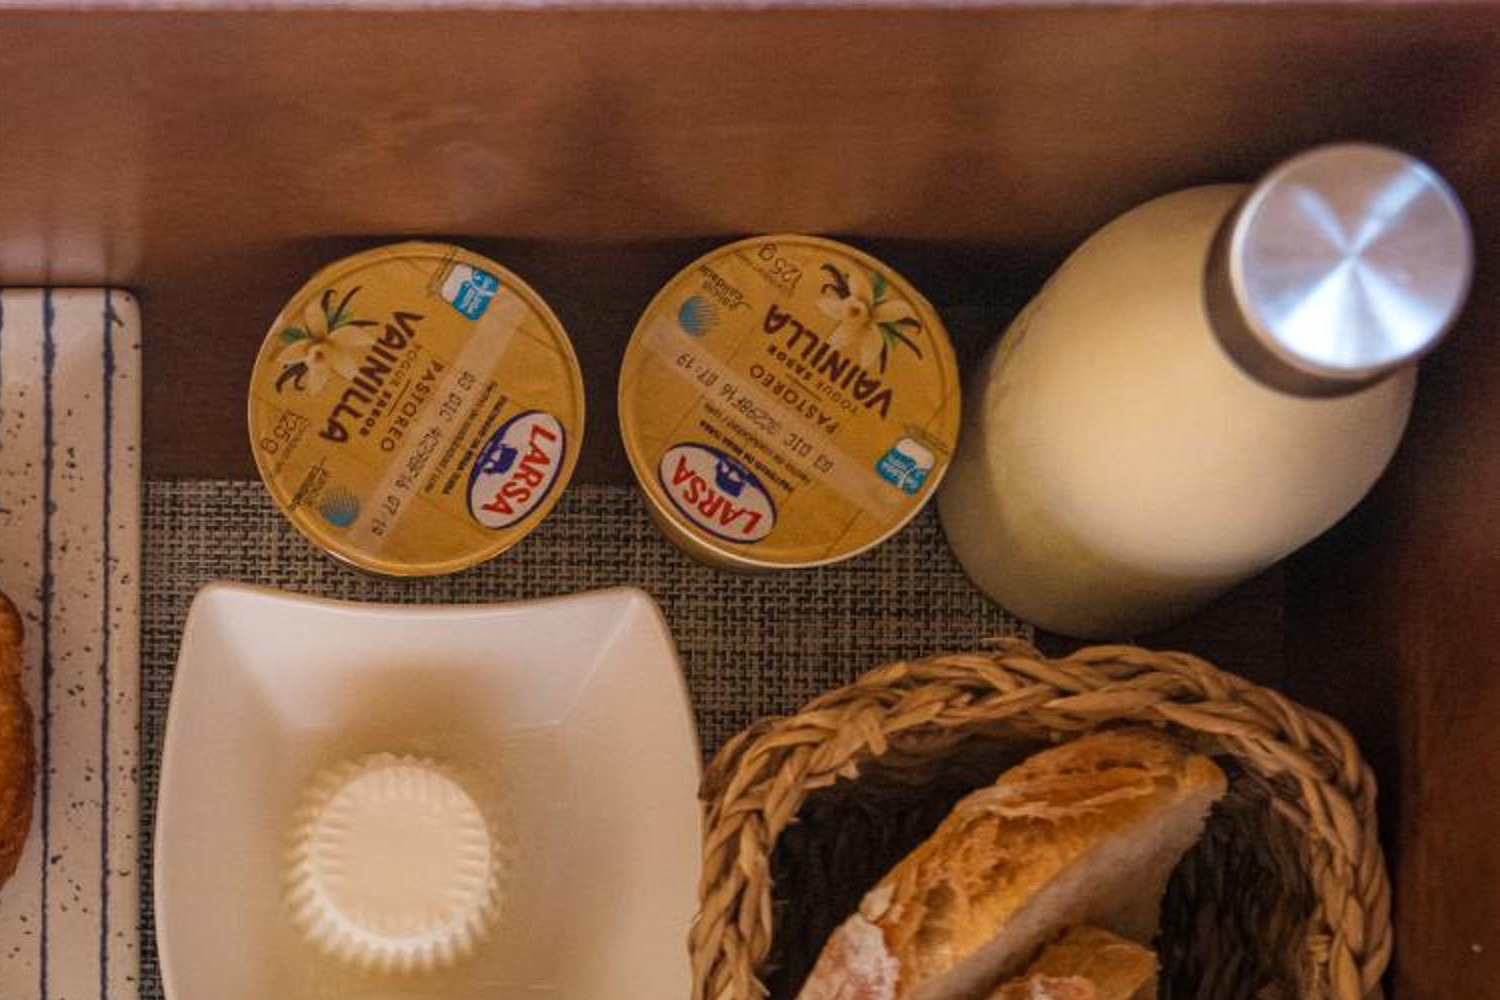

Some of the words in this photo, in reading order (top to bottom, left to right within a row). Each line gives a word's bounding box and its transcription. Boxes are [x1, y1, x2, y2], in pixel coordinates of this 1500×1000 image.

[319, 312, 424, 442] VAINILLA
[380, 360, 442, 450] PASTOREO
[749, 363, 838, 434] PASTOREO
[763, 304, 892, 418] VAINILLA
[481, 424, 557, 515] LARSA
[672, 456, 762, 535] LARSA
